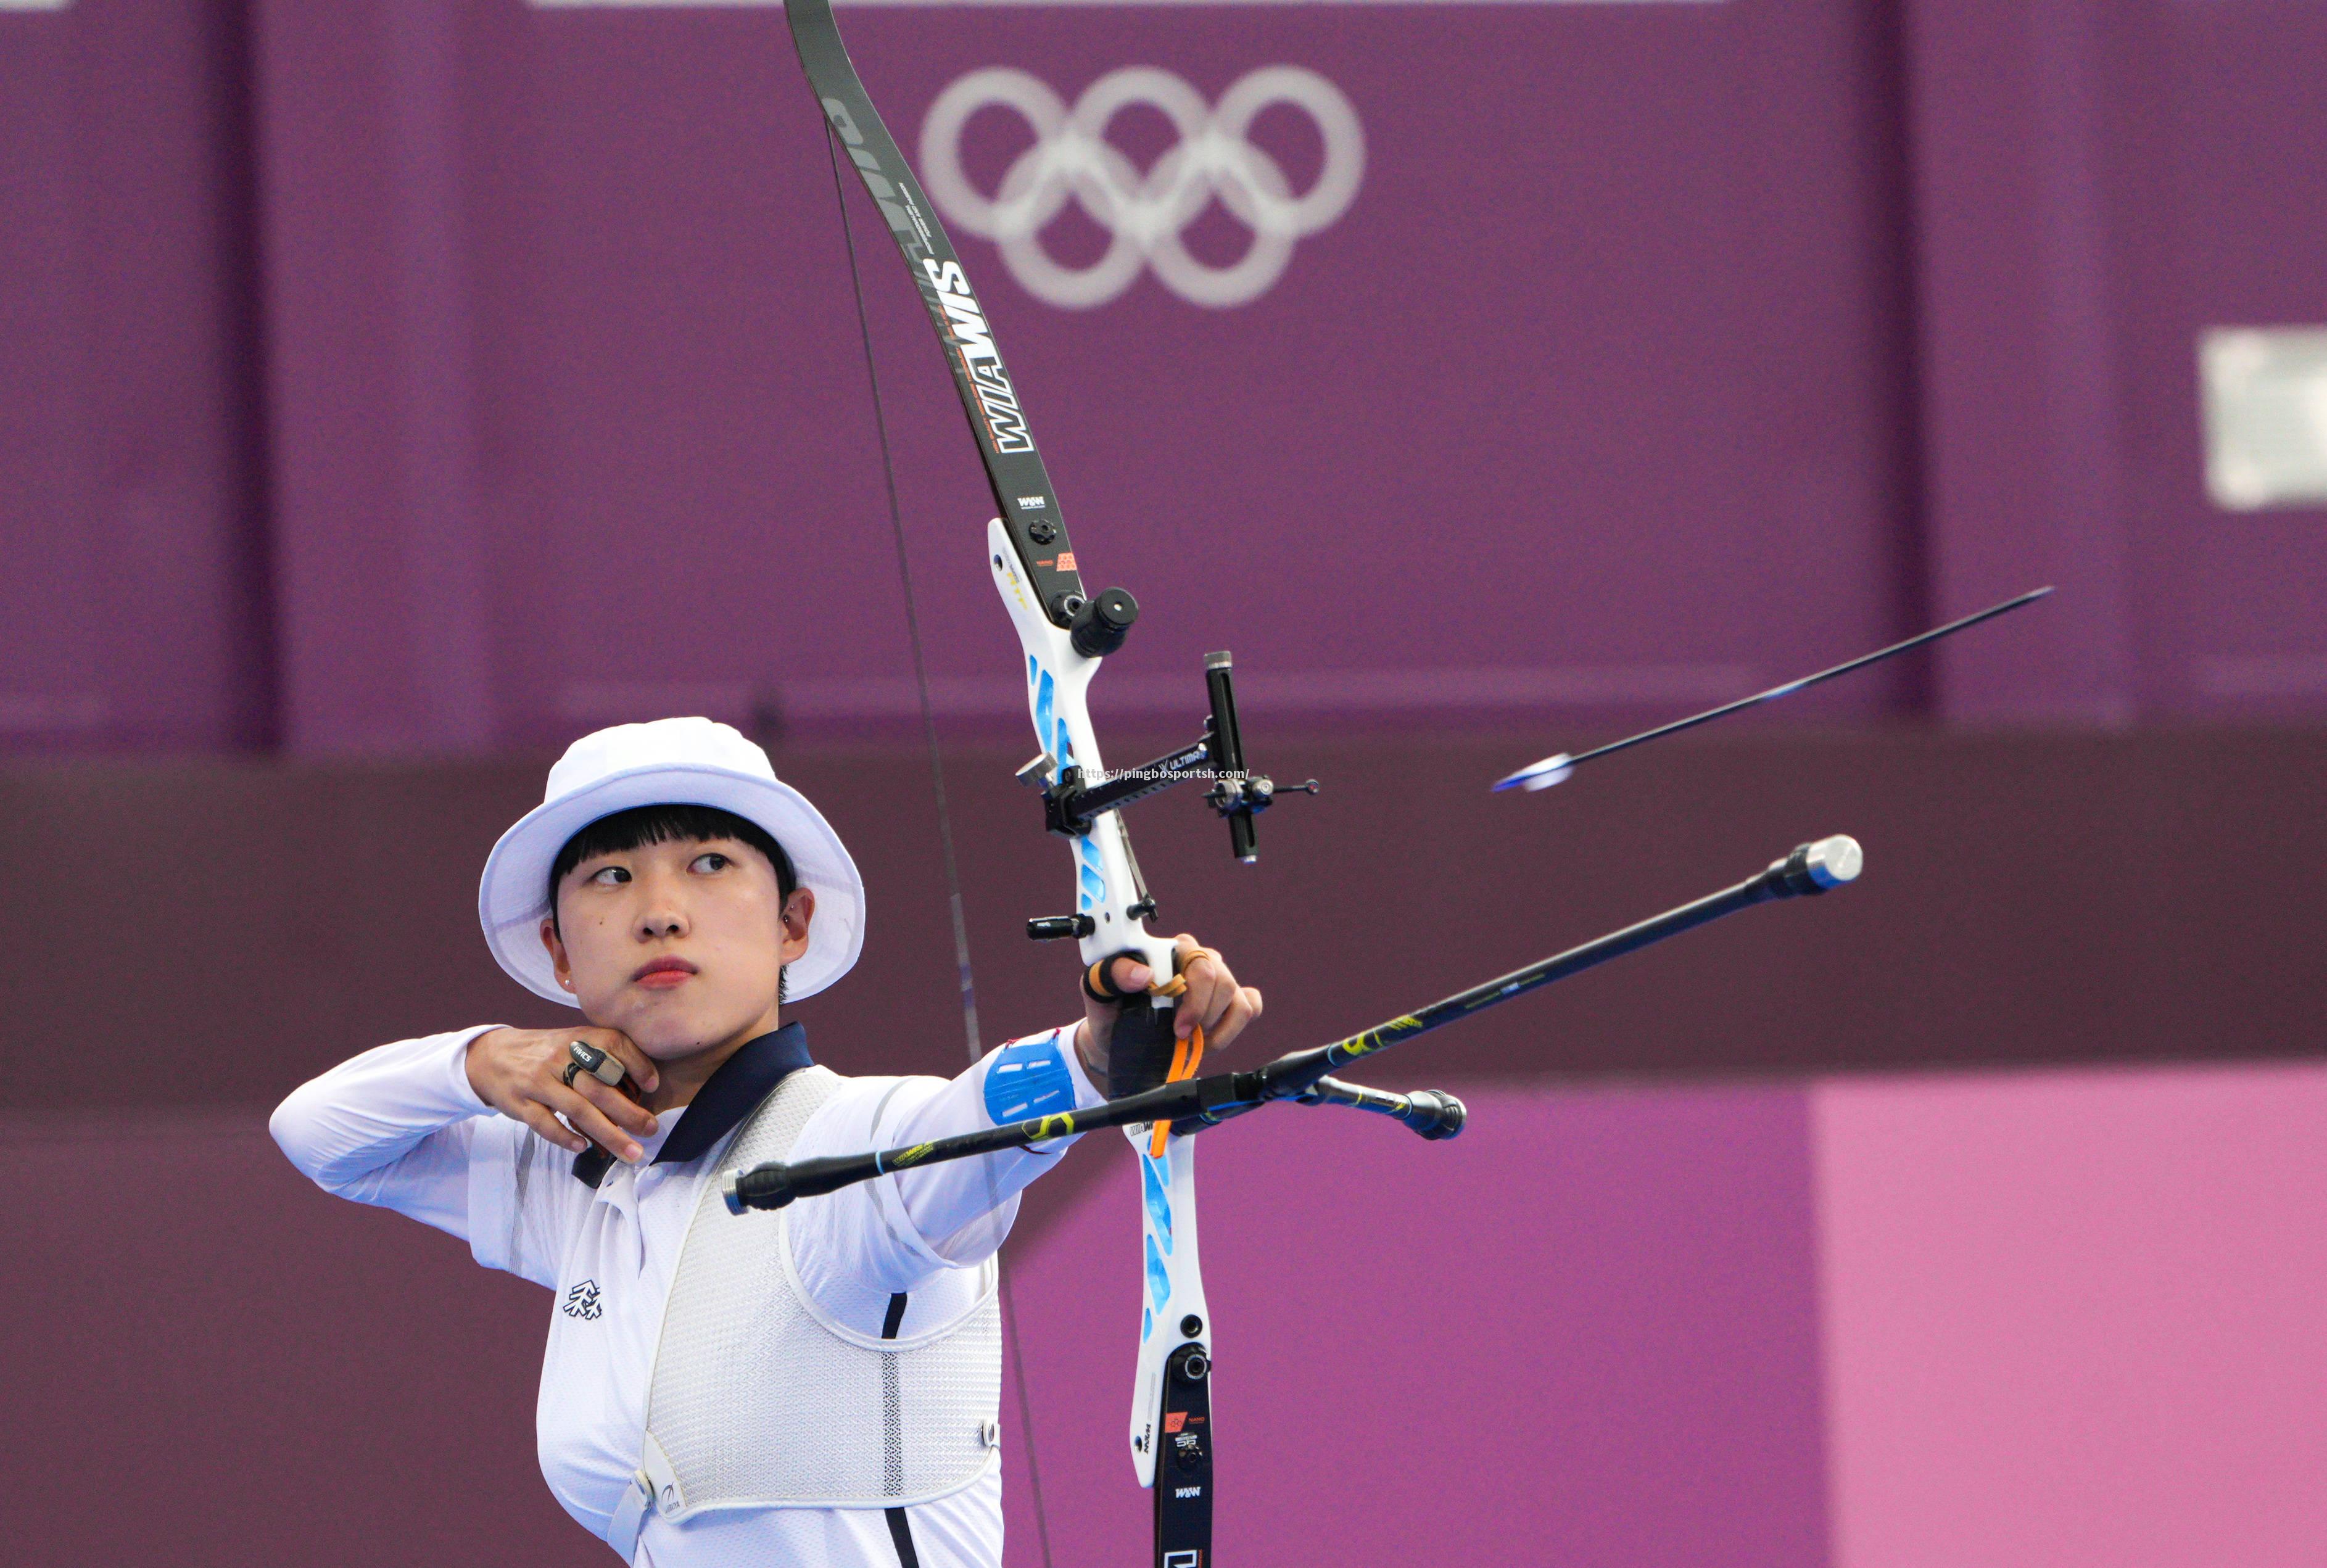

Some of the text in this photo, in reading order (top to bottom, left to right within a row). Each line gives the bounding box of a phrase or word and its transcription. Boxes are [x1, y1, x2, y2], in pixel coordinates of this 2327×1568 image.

[923, 258, 1035, 453] WIAWIS
[573, 1046, 592, 1062] FIVICS
[1175, 1487, 1201, 1498] W&W
